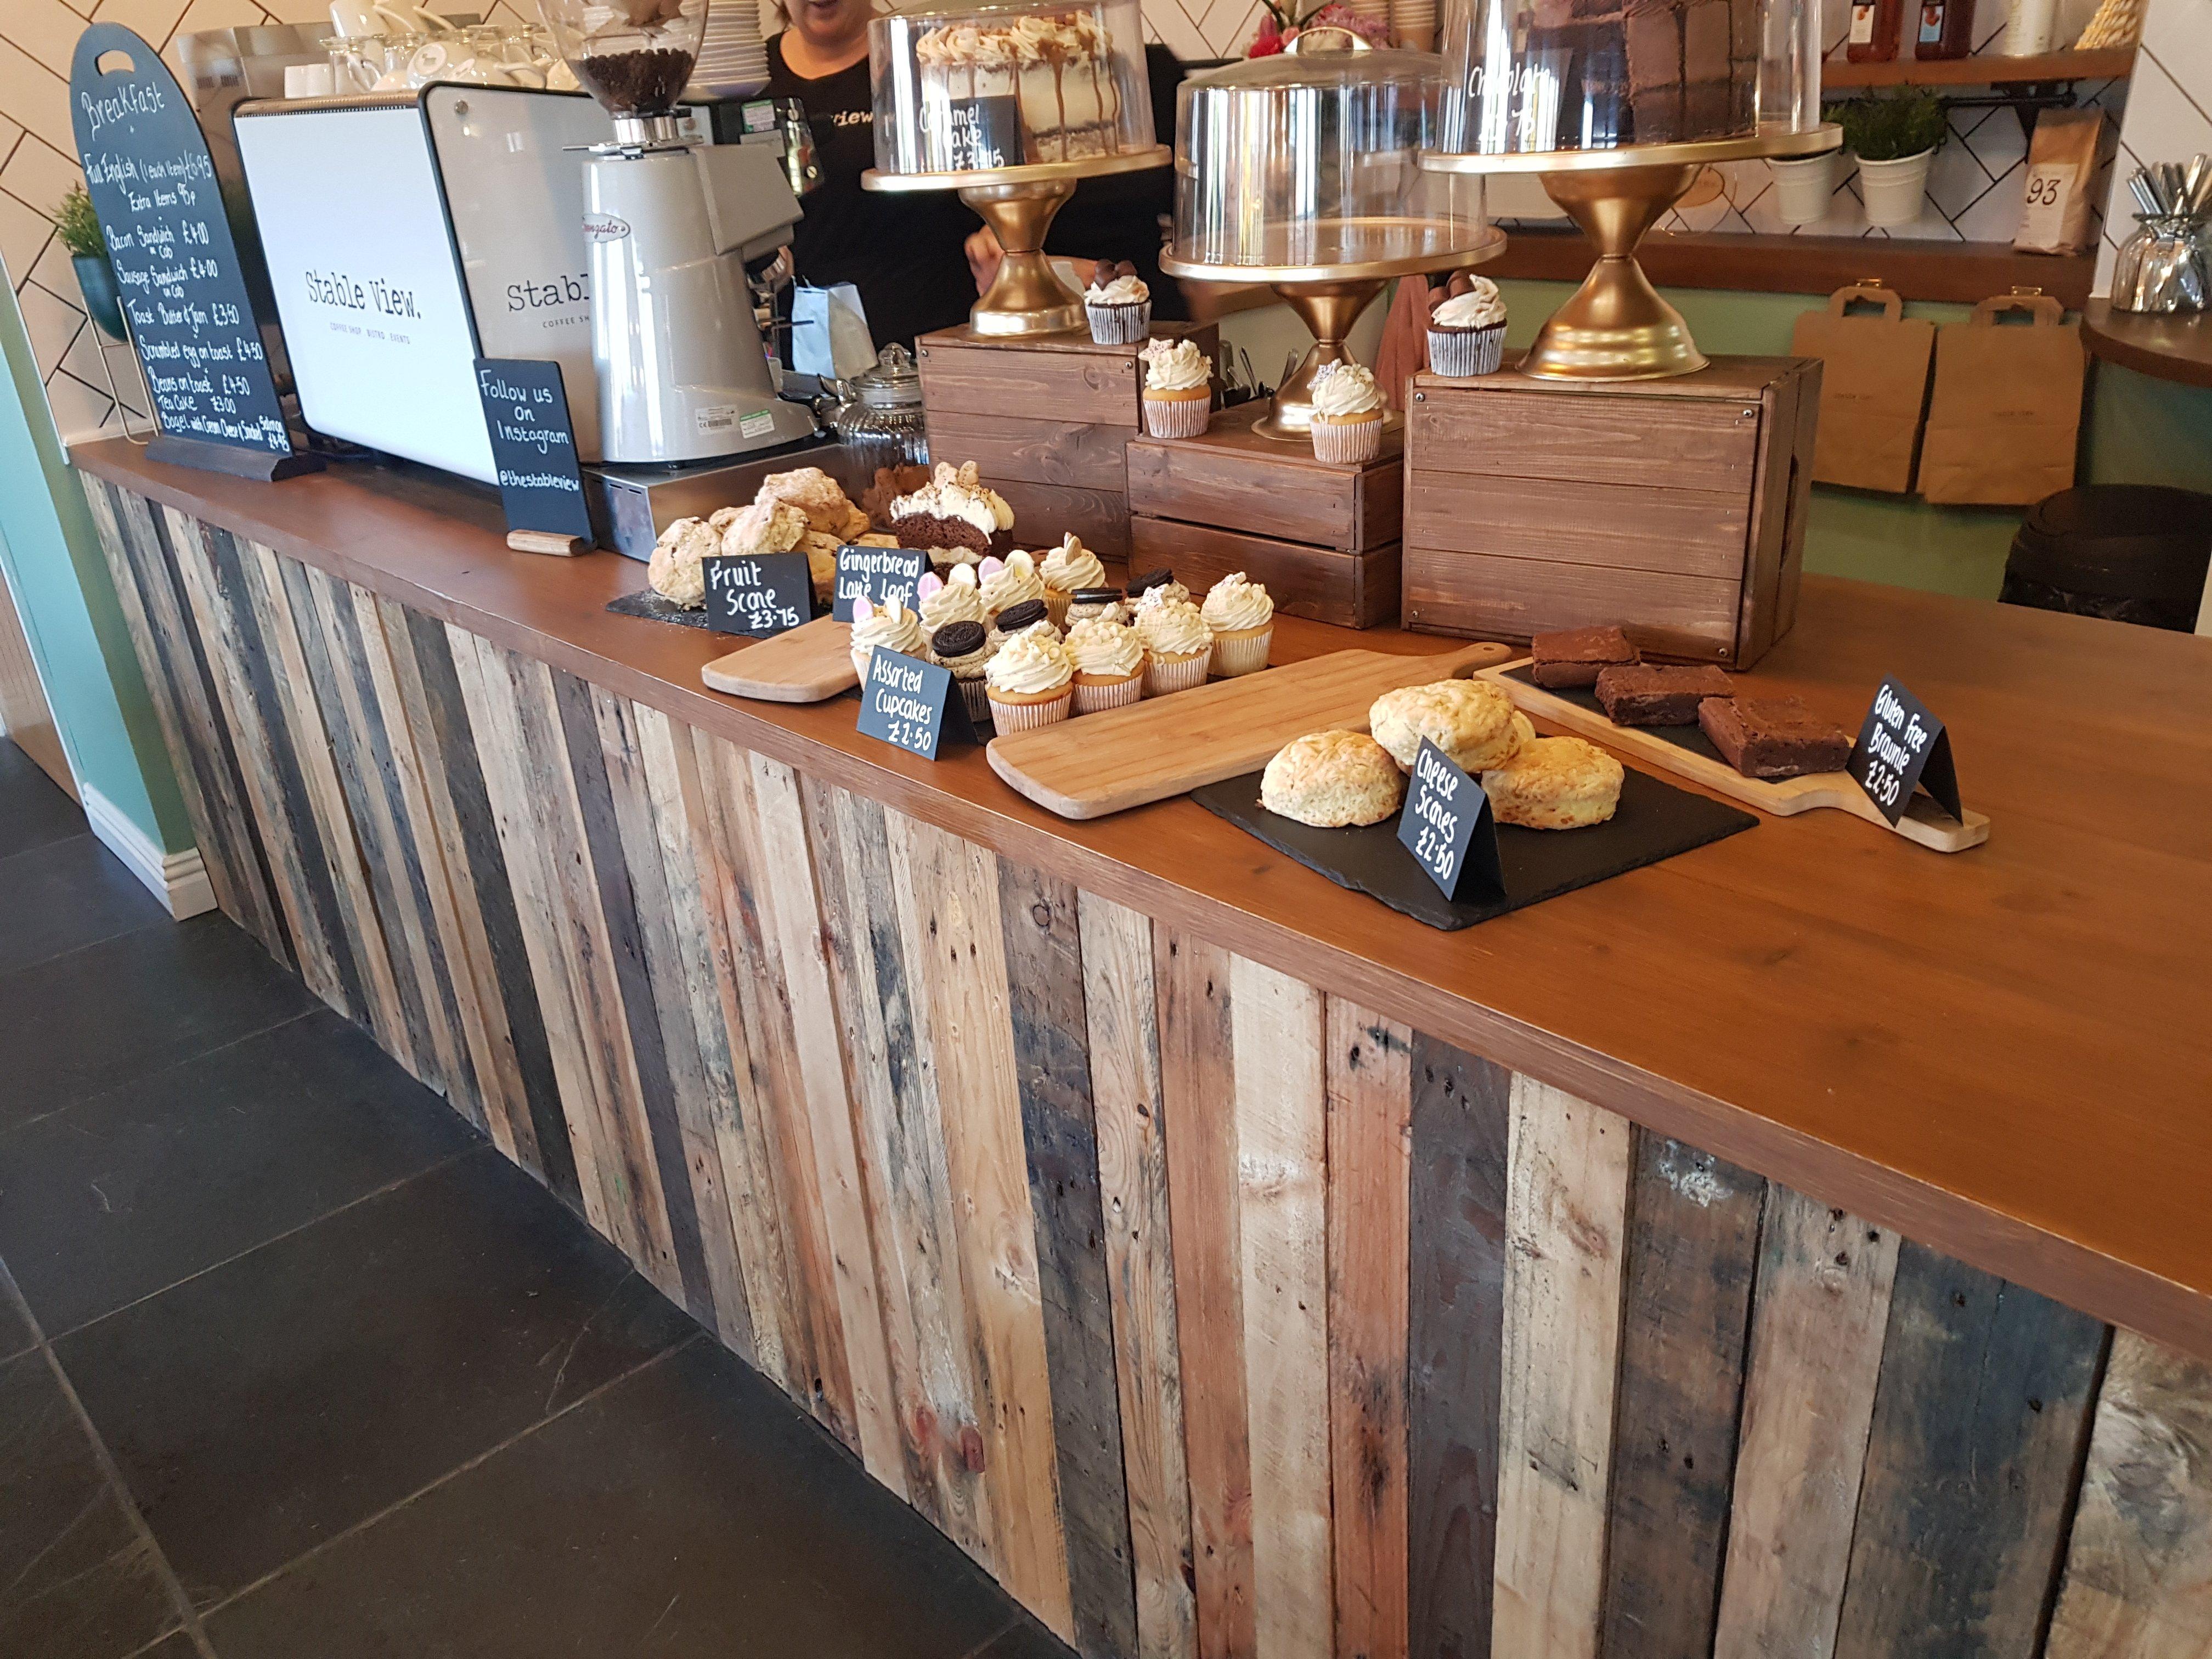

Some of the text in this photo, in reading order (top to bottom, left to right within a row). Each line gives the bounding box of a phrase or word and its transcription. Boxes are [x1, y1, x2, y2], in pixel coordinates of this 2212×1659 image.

[951, 127, 982, 149] ake
[84, 153, 104, 184] Full
[101, 152, 139, 195] English
[128, 191, 151, 212] Extra
[2027, 178, 2061, 206] 93
[106, 224, 135, 251] Bacon
[137, 224, 175, 247] Sandwich
[116, 259, 150, 295] Sausage
[150, 264, 189, 287] Sandwich
[306, 269, 421, 319] Stable View.
[127, 298, 155, 325] Toast
[543, 317, 575, 328] COFFEE
[139, 334, 180, 361] Scrambled
[183, 345, 201, 368] egg
[199, 347, 208, 360] on
[207, 341, 233, 361] toast
[148, 365, 178, 394] Beans
[178, 377, 189, 392] on
[186, 371, 213, 393] toast
[480, 369, 553, 404] Follow us
[157, 395, 174, 410] Tea
[161, 411, 191, 432] Bagel
[496, 420, 569, 455] Instagram
[499, 470, 579, 491] @thestableview
[710, 560, 761, 590] Fruit
[840, 548, 919, 583] Gingerbread
[726, 588, 777, 616] Scone
[748, 606, 800, 629] £3.75
[872, 654, 923, 694] Assorted
[876, 688, 933, 725] Cupcakes
[1875, 684, 1905, 730] Gluten
[888, 720, 932, 751] £2.50
[1868, 721, 1910, 776] Brownie
[1417, 748, 1458, 801] Cheese
[1865, 760, 1900, 806] £2.50
[1415, 785, 1458, 843] Scones
[1415, 826, 1454, 880] £2.50
